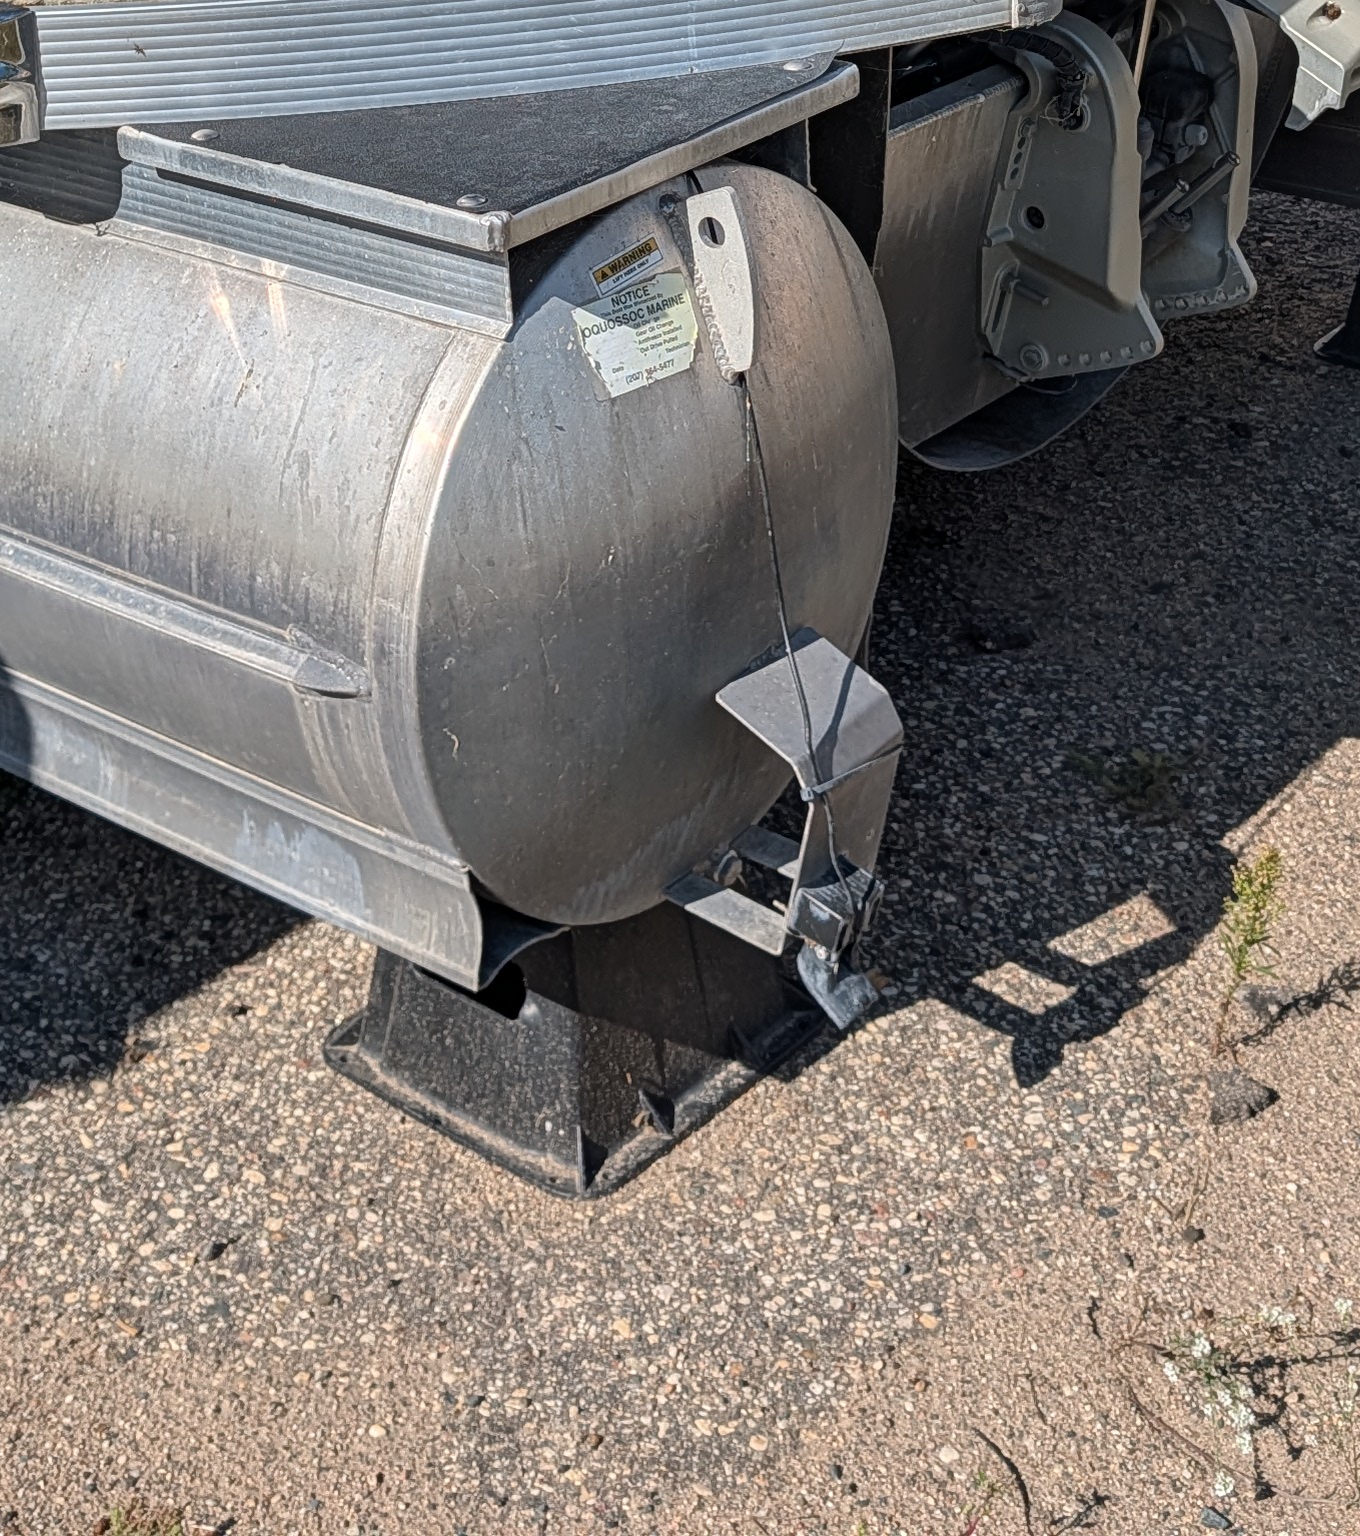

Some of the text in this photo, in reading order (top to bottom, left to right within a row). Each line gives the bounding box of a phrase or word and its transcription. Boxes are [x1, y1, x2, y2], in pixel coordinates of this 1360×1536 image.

[608, 242, 653, 273] WARNING
[612, 258, 650, 284] LIFT HERE ONLY
[611, 286, 650, 307] NOTICE
[647, 293, 685, 315] MARINE
[656, 319, 674, 330] Change
[625, 372, 644, 386] (207)
